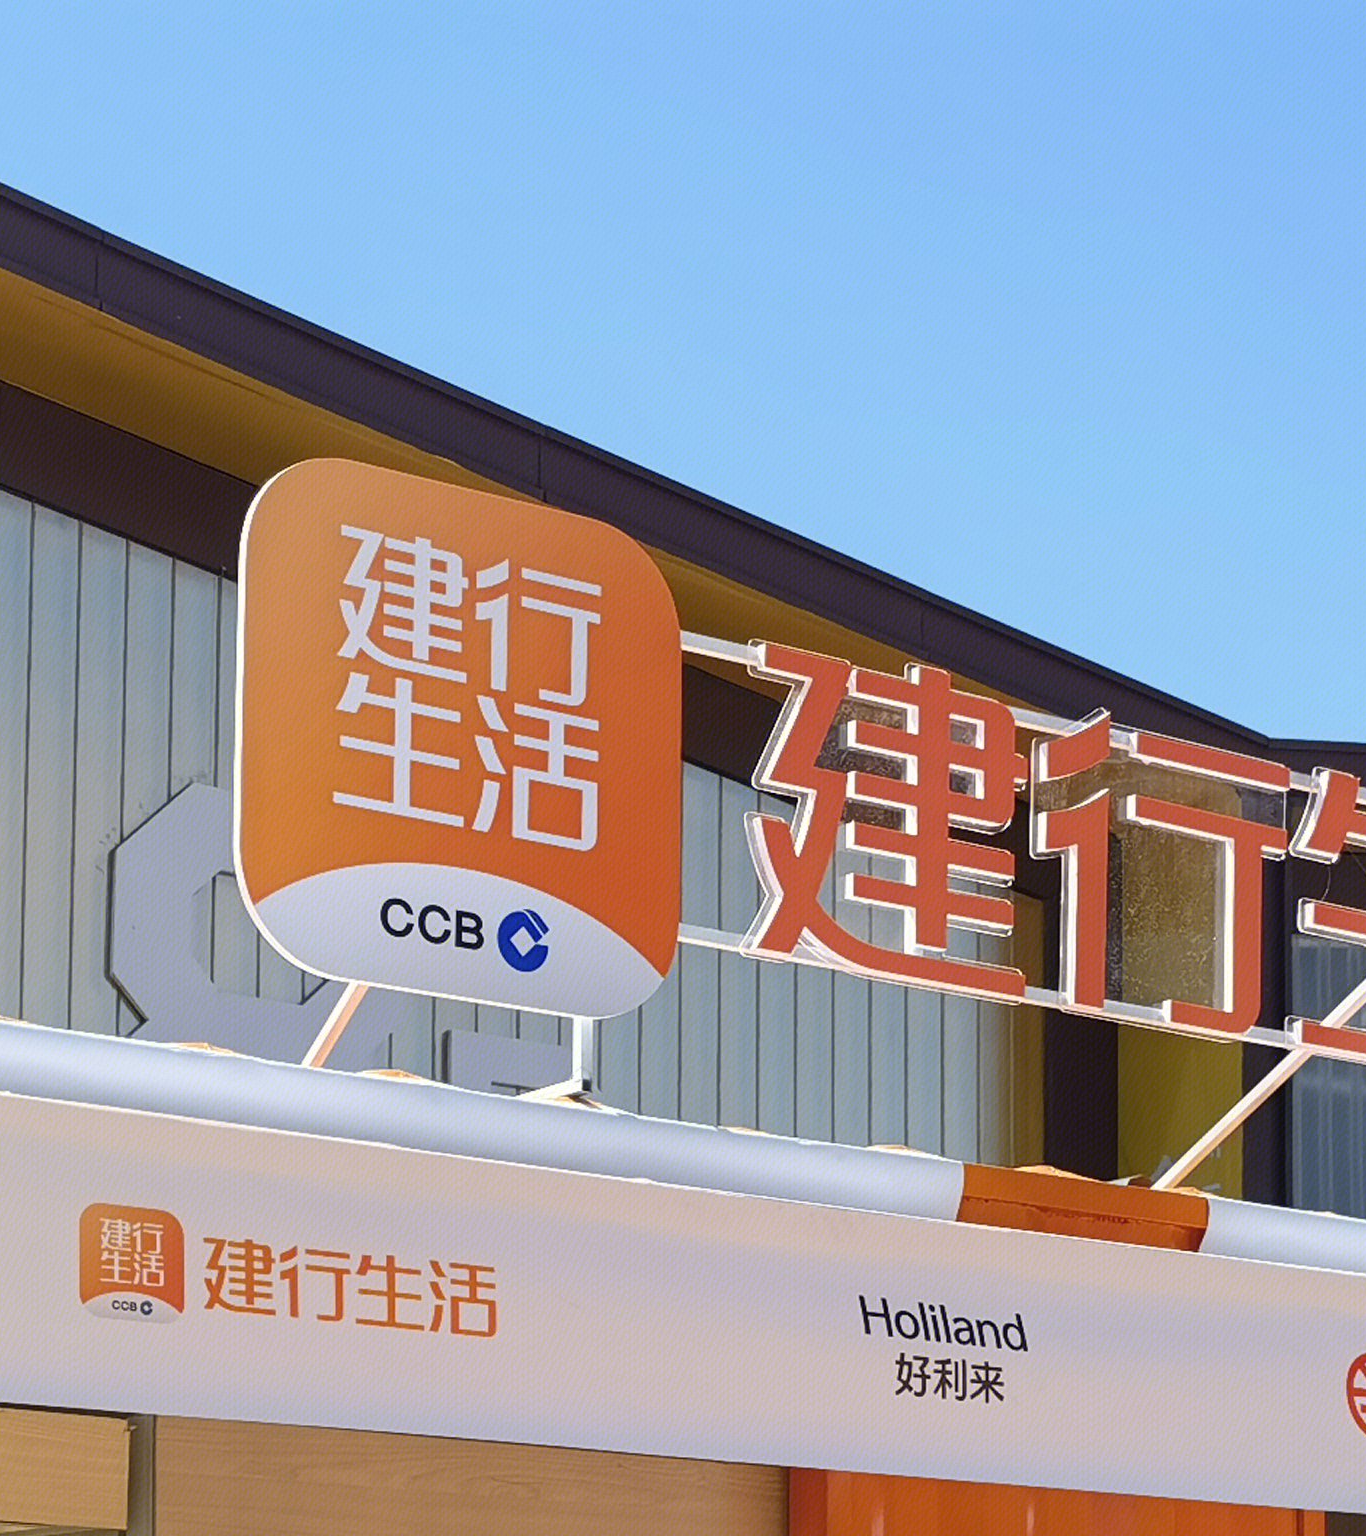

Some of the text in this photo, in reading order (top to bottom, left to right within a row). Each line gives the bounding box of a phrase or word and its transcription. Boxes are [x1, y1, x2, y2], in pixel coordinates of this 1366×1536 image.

[337, 524, 602, 707] 建行
[332, 672, 600, 852] 生活
[380, 897, 485, 951] CCB
[99, 1217, 165, 1254] 建行
[99, 1252, 165, 1288] 生活
[202, 1237, 498, 1338] 建行生活
[111, 1299, 138, 1312] CCB
[858, 1295, 1029, 1351] Holiland
[894, 1353, 1005, 1403] 好利来
